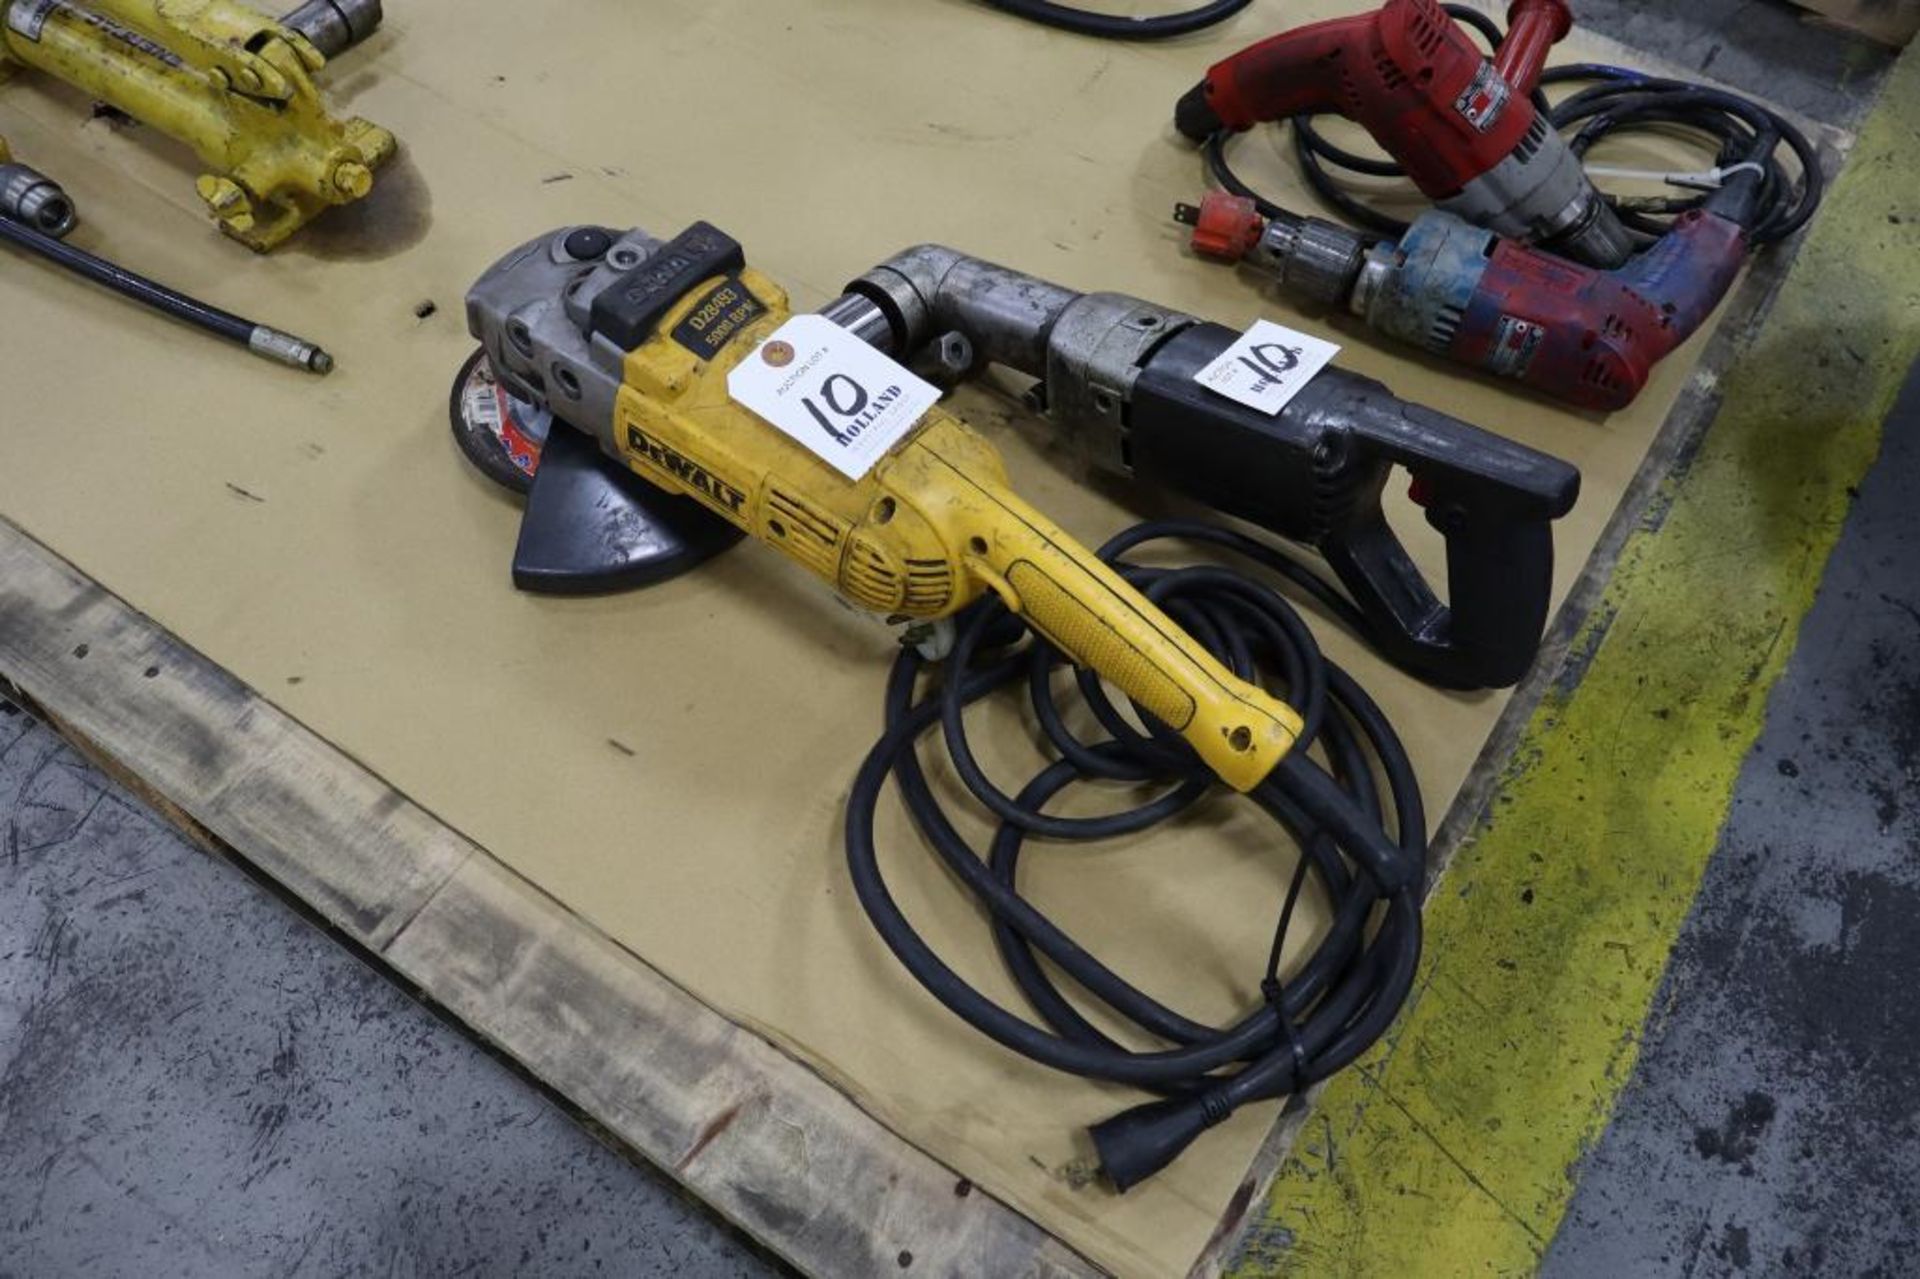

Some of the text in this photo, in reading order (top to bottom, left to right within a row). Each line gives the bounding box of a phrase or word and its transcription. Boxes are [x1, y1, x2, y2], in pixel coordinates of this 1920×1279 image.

[688, 287, 738, 331] D28493
[1237, 342, 1300, 385] 10
[801, 373, 868, 438] 10
[836, 384, 902, 448] HOLLAND
[627, 422, 747, 513] DEWALT
